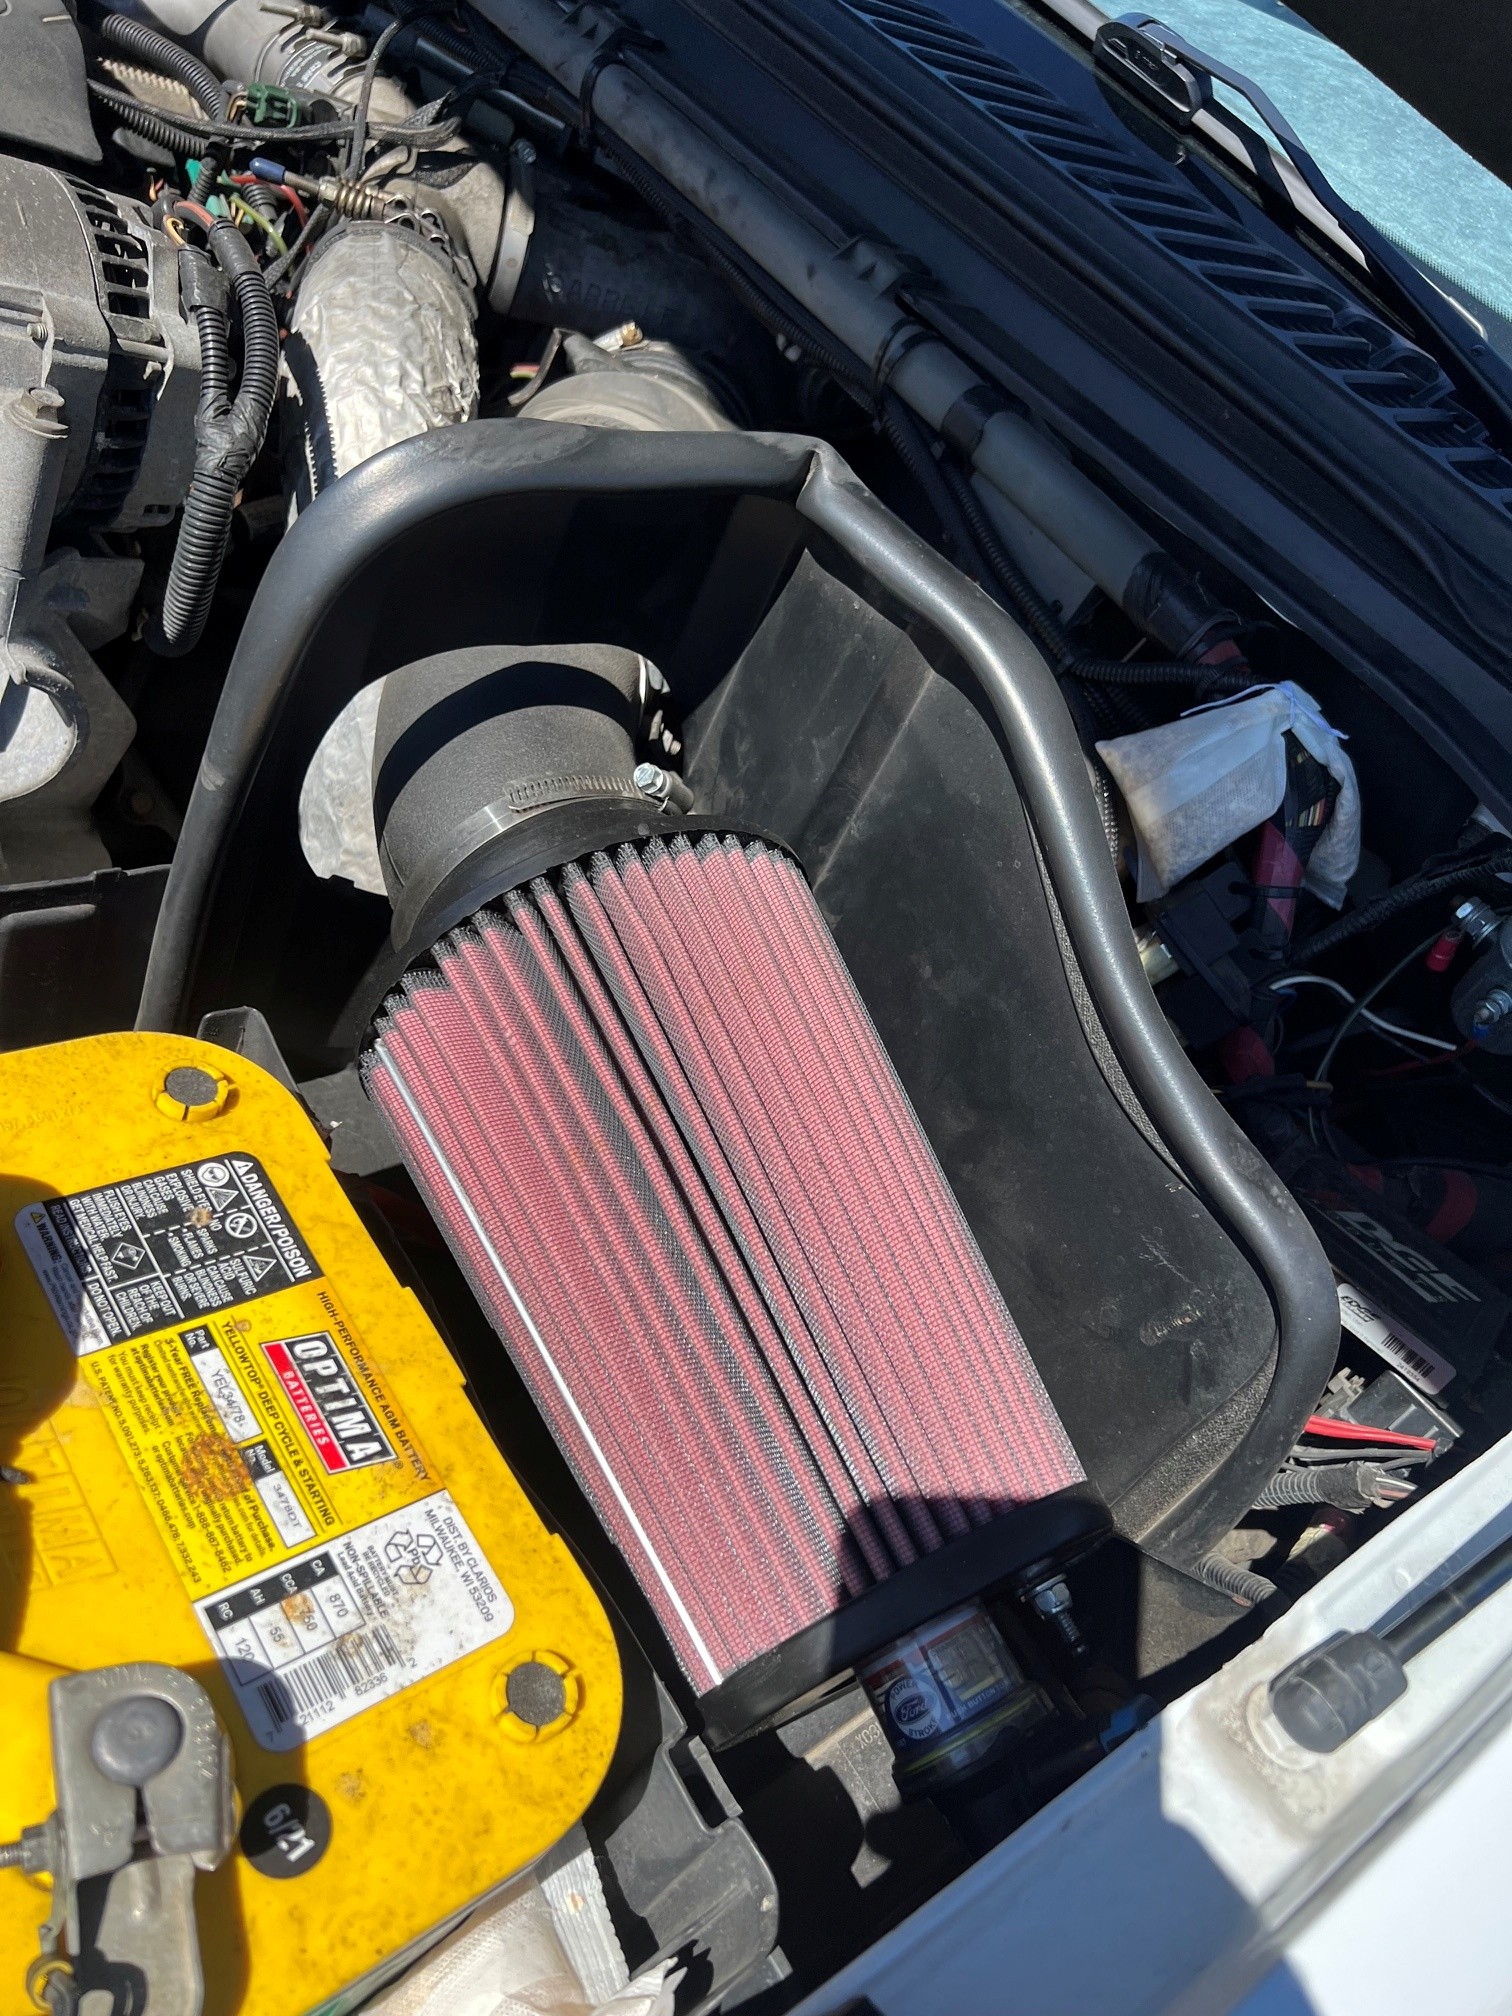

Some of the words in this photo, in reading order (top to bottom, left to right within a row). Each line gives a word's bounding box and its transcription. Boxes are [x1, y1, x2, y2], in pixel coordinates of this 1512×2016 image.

[119, 1184, 133, 1195] OR
[130, 1181, 158, 1218] BLINDNESS
[141, 1178, 158, 1193] CAN
[152, 1175, 175, 1201] GASES
[163, 1172, 196, 1212] EXPLOSIVE
[179, 1168, 203, 1195] SHIELD
[192, 1192, 213, 1213] EYES
[48, 1204, 68, 1224] READ
[67, 1198, 85, 1214] GET
[79, 1195, 98, 1214] WITH
[90, 1192, 124, 1239] IMMEDIATELY
[102, 1189, 124, 1214] FLUSH
[114, 1211, 133, 1231] EYES
[123, 1193, 146, 1220] INJURY.
[148, 1191, 169, 1214] CAUSE
[74, 1212, 100, 1244] MEDICAL
[88, 1213, 112, 1242] WATER.
[206, 1218, 223, 1231] NO
[238, 1172, 313, 1278] DANGER/POISON
[34, 1222, 64, 1264] WARNING:
[90, 1242, 109, 1262] HELP
[166, 1235, 192, 1267] SMOKING
[180, 1231, 204, 1259] FLAMES
[195, 1227, 219, 1255] SPARKS
[98, 1260, 119, 1283] FAST.
[182, 1271, 197, 1283] OR
[204, 1264, 221, 1280] CAN
[216, 1261, 236, 1281] ACID
[227, 1257, 258, 1295] SULFURIC
[86, 1282, 103, 1296] DO
[138, 1283, 153, 1296] OF
[149, 1280, 169, 1301] KEEP
[159, 1299, 177, 1317] OUT
[170, 1275, 193, 1302] BURNS.
[187, 1281, 210, 1309] SEVERE
[193, 1268, 223, 1307] BLINDNESS
[212, 1278, 234, 1303] CAUSE
[92, 1294, 111, 1312] NOT
[114, 1290, 144, 1331] CHILDREN.
[126, 1287, 148, 1313] REACH
[138, 1311, 154, 1325] OF
[143, 1294, 160, 1311] THE
[100, 1310, 123, 1337] OPEN.
[193, 1328, 211, 1348] Part
[129, 1346, 140, 1355] at
[162, 1336, 185, 1366] 3-Year
[182, 1332, 199, 1348] No.
[89, 1360, 104, 1377] U.S.
[106, 1354, 118, 1366] for
[116, 1350, 131, 1365] You
[138, 1343, 161, 1374] Register
[153, 1373, 168, 1390] your
[109, 1365, 134, 1399] warranty
[123, 1364, 140, 1386] must
[177, 1365, 197, 1390] FREE
[314, 1290, 388, 1403] HIGH-PERFORMANCE
[378, 1401, 402, 1429] AGM
[392, 1428, 433, 1483] BATTERY
[96, 1375, 117, 1405] PATENT
[132, 1384, 150, 1404] keep
[288, 1335, 386, 1462] OPTIMA
[141, 1402, 162, 1430] receipt
[255, 1390, 281, 1421] DEEP
[279, 1368, 332, 1446] BATTERIES
[150, 1444, 160, 1453] or
[271, 1420, 300, 1458] CYCLE
[252, 1443, 277, 1473] Model
[291, 1457, 306, 1468] &
[152, 1452, 198, 1530] optimabatteries.com
[242, 1493, 255, 1505] of
[296, 1467, 337, 1527] STARTING
[160, 1440, 185, 1476] Customer
[191, 1503, 232, 1573] 1-888-867-8462
[270, 1482, 303, 1530] 3478DT
[218, 1501, 237, 1526] return
[228, 1524, 251, 1554] battery
[243, 1552, 255, 1562] to
[244, 1521, 256, 1533] for
[247, 1503, 279, 1551] Purchase.
[215, 1522, 244, 1566] purchased.
[361, 1550, 372, 1561] BE
[405, 1546, 424, 1566] Pb
[366, 1544, 388, 1576] BATTERY
[382, 1575, 399, 1597] MUST
[422, 1507, 467, 1572] MILWAUKEE,
[458, 1570, 475, 1587] WI
[467, 1585, 495, 1622] 53209
[441, 1515, 464, 1543] DIST.
[456, 1541, 473, 1558] BY
[465, 1556, 498, 1603] CLARIOS
[279, 1572, 299, 1595] CCA
[309, 1558, 327, 1577] CA
[327, 1591, 349, 1618] 870
[336, 1550, 352, 1568] Lead
[344, 1567, 361, 1588] Acid
[354, 1586, 377, 1617] Battery
[341, 1540, 390, 1619] NON-SPILLABLE
[366, 1560, 391, 1597] RECYCLED
[248, 1586, 266, 1605] AH
[268, 1625, 285, 1643] 55
[216, 1601, 234, 1621] RC
[233, 1635, 256, 1664] 120
[297, 1699, 336, 1726] 21112
[353, 1671, 389, 1697] 82336
[896, 1695, 932, 1722] Ford
[263, 1802, 316, 1863] 6/21
